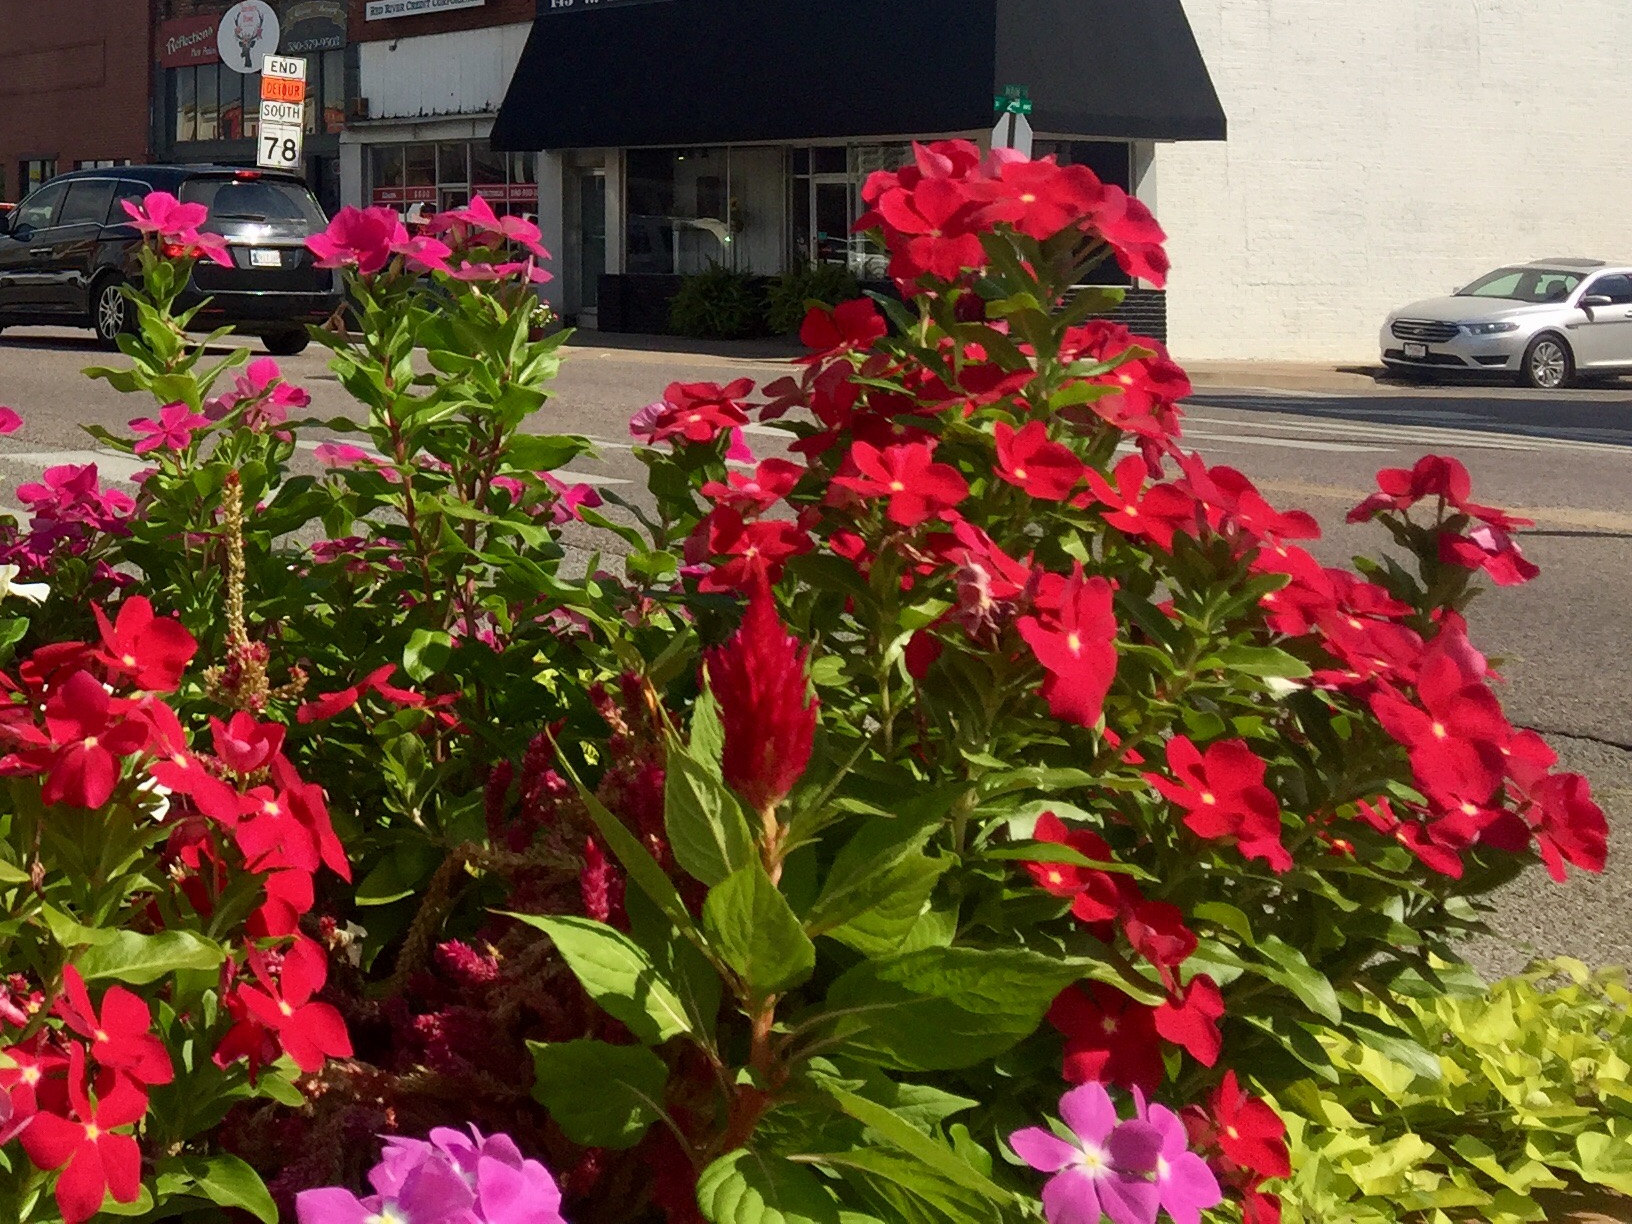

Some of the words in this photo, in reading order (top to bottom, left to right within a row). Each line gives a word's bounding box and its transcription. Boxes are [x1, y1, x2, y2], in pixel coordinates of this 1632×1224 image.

[166, 27, 214, 55] Reflections
[270, 61, 297, 74] END
[267, 82, 300, 97] DETOUR
[264, 105, 300, 119] SOUTH
[264, 136, 296, 162] 78
